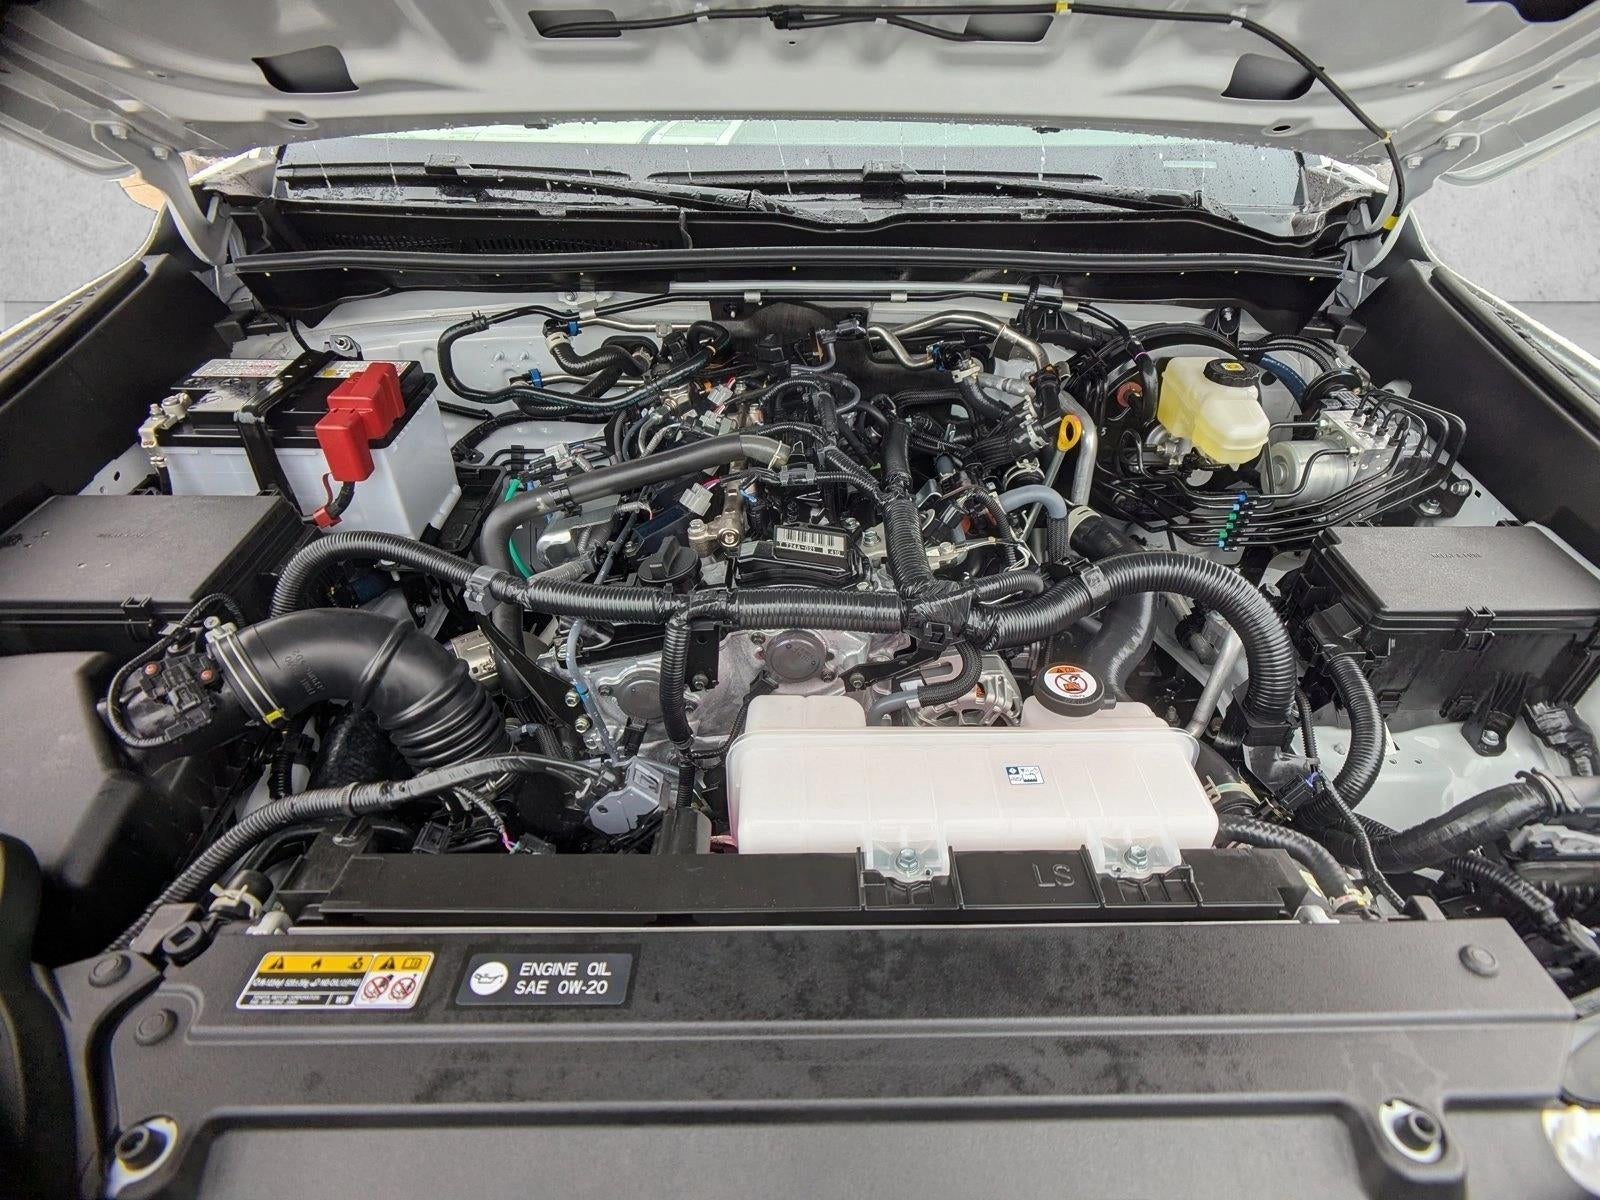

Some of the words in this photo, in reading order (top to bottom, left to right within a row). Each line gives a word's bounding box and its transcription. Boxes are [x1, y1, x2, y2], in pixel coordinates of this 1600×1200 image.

[1032, 862, 1075, 888] LS
[519, 962, 579, 977] ENGINE
[587, 962, 612, 976] OIL
[514, 980, 549, 995] SAE
[557, 980, 608, 995] 0W-20
